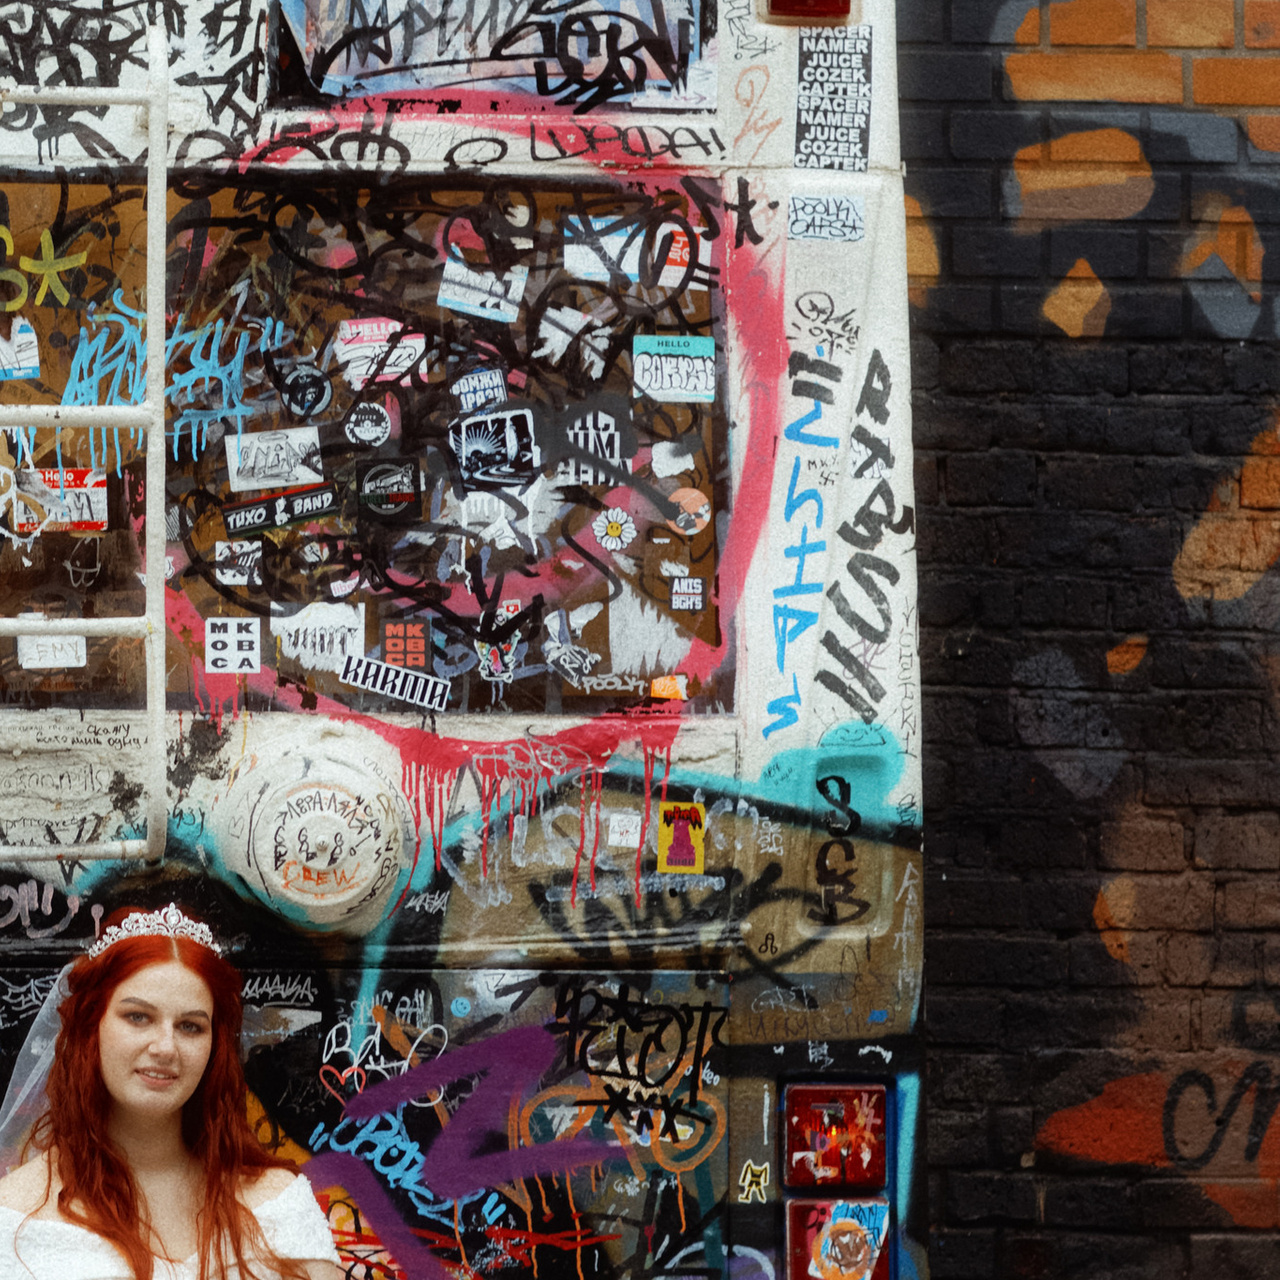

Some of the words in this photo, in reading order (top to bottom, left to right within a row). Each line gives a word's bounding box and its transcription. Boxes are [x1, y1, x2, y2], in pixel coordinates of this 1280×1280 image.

[800, 26, 871, 39] SPACER
[802, 38, 868, 53] NAMER
[807, 53, 863, 67] JUICE
[802, 67, 867, 83] COZEK
[798, 81, 871, 97] CAPTEK
[798, 95, 870, 114] SPACER
[800, 111, 867, 128] NAMER
[804, 126, 860, 142] JUICE
[799, 140, 863, 157] COZEK
[794, 153, 868, 172] CAPTEK
[351, 320, 401, 338] HELLO
[657, 339, 691, 348] HELLO
[45, 470, 74, 481] Helo
[293, 492, 333, 516] BAND
[672, 578, 703, 594] ANIS
